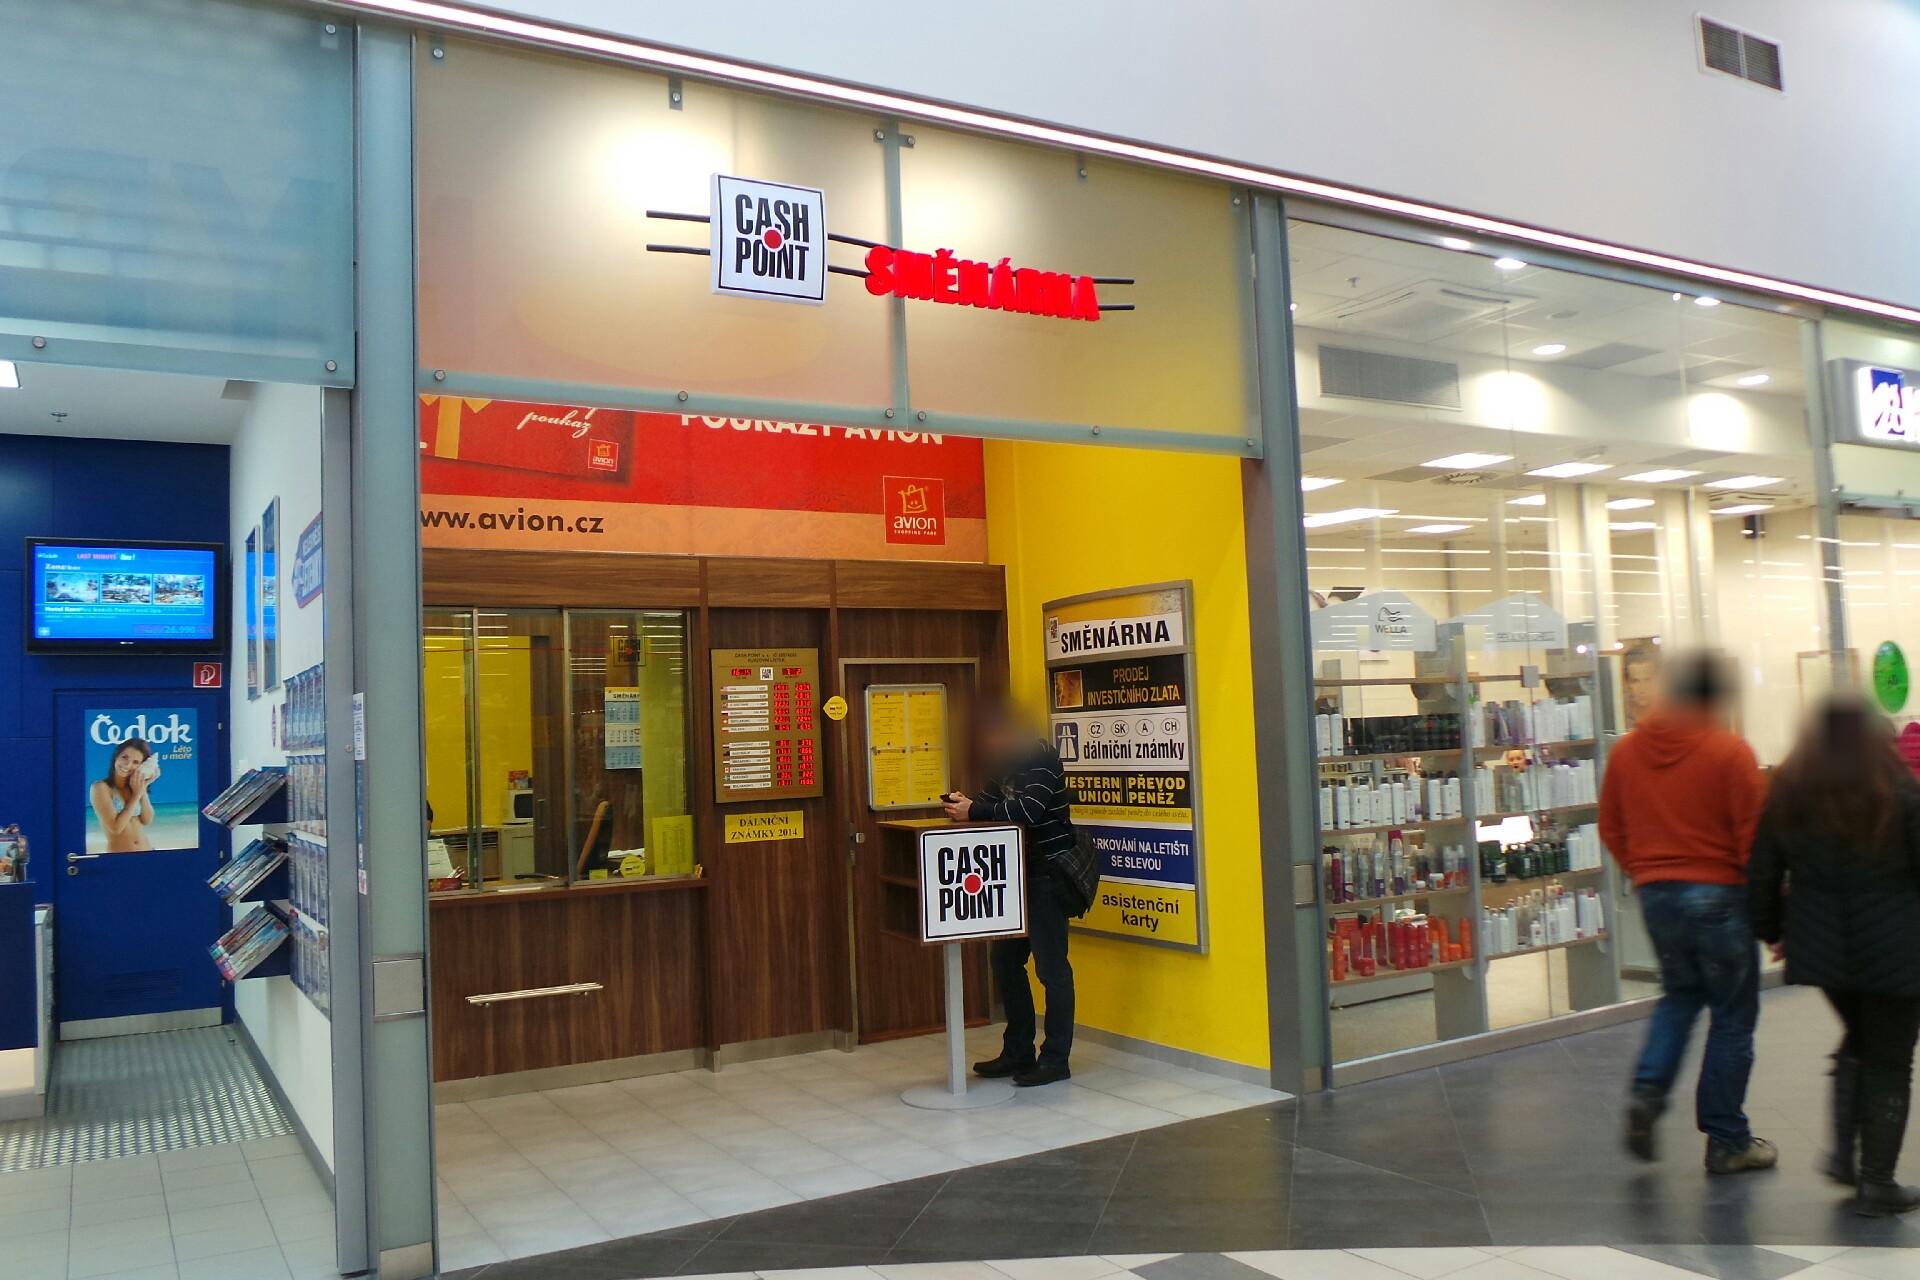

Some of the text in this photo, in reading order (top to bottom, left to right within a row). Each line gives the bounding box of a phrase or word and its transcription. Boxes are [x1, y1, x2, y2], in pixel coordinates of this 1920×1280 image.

[735, 194, 810, 243] CASH
[735, 237, 810, 281] POINT
[864, 246, 1100, 322] SMĚNÁRNA
[516, 410, 592, 439] poukaz
[893, 515, 937, 530] avion
[1061, 620, 1171, 653] SMĚNÁRNA
[1375, 624, 1407, 633] WELLA
[1113, 665, 1150, 683] PRODEJ
[1087, 685, 1181, 706] INVESTIČNÍHO ZLATA
[90, 713, 193, 746] Čedok
[1090, 725, 1101, 735] CZ
[1114, 724, 1126, 734] SK
[1142, 723, 1148, 733] A
[1164, 722, 1177, 732] CH
[1083, 739, 1185, 760] dálniční známky
[1065, 774, 1186, 790] ESTERN PŘEVOD
[1078, 789, 1175, 805] UNION PENĚZ
[739, 815, 789, 827] DÁLNIČNÍ
[731, 828, 798, 840] ZNÁMKY 2014
[1138, 841, 1152, 854] NA
[1153, 841, 1189, 856] LETIŠTI
[937, 844, 1007, 886] CASH
[1111, 855, 1162, 871] SE SLEVOU
[938, 884, 1007, 922] POINT
[1102, 893, 1179, 914] asistenční
[1121, 910, 1159, 933] karty
